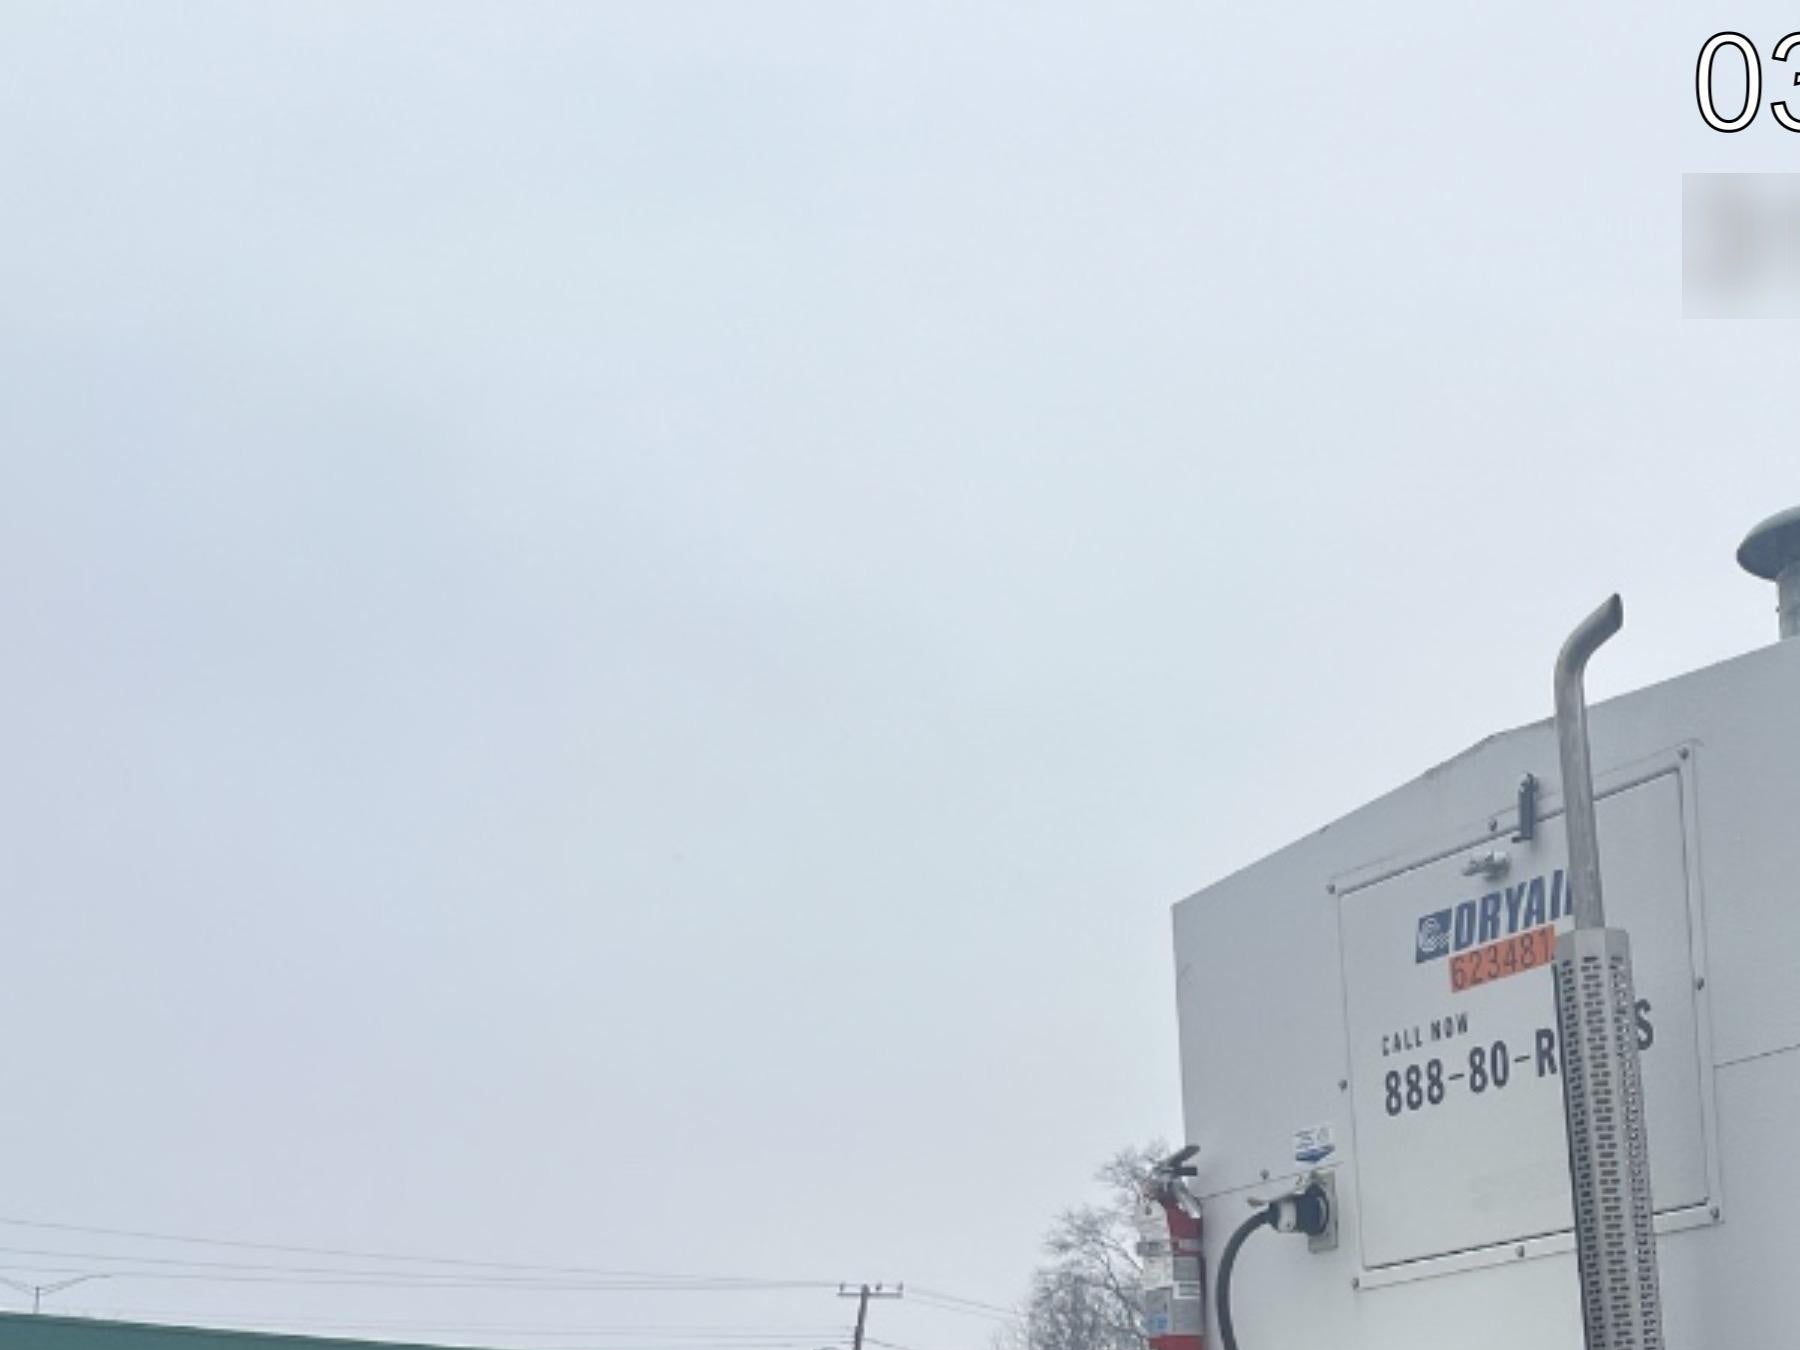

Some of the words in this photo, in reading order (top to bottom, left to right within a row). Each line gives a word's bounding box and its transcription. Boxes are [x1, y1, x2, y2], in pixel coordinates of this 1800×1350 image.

[1451, 928, 1557, 992] 623481
[1381, 1027, 1423, 1057] CALL
[1430, 1012, 1470, 1042] NOW
[1384, 998, 1654, 1117] 888-80-RS
